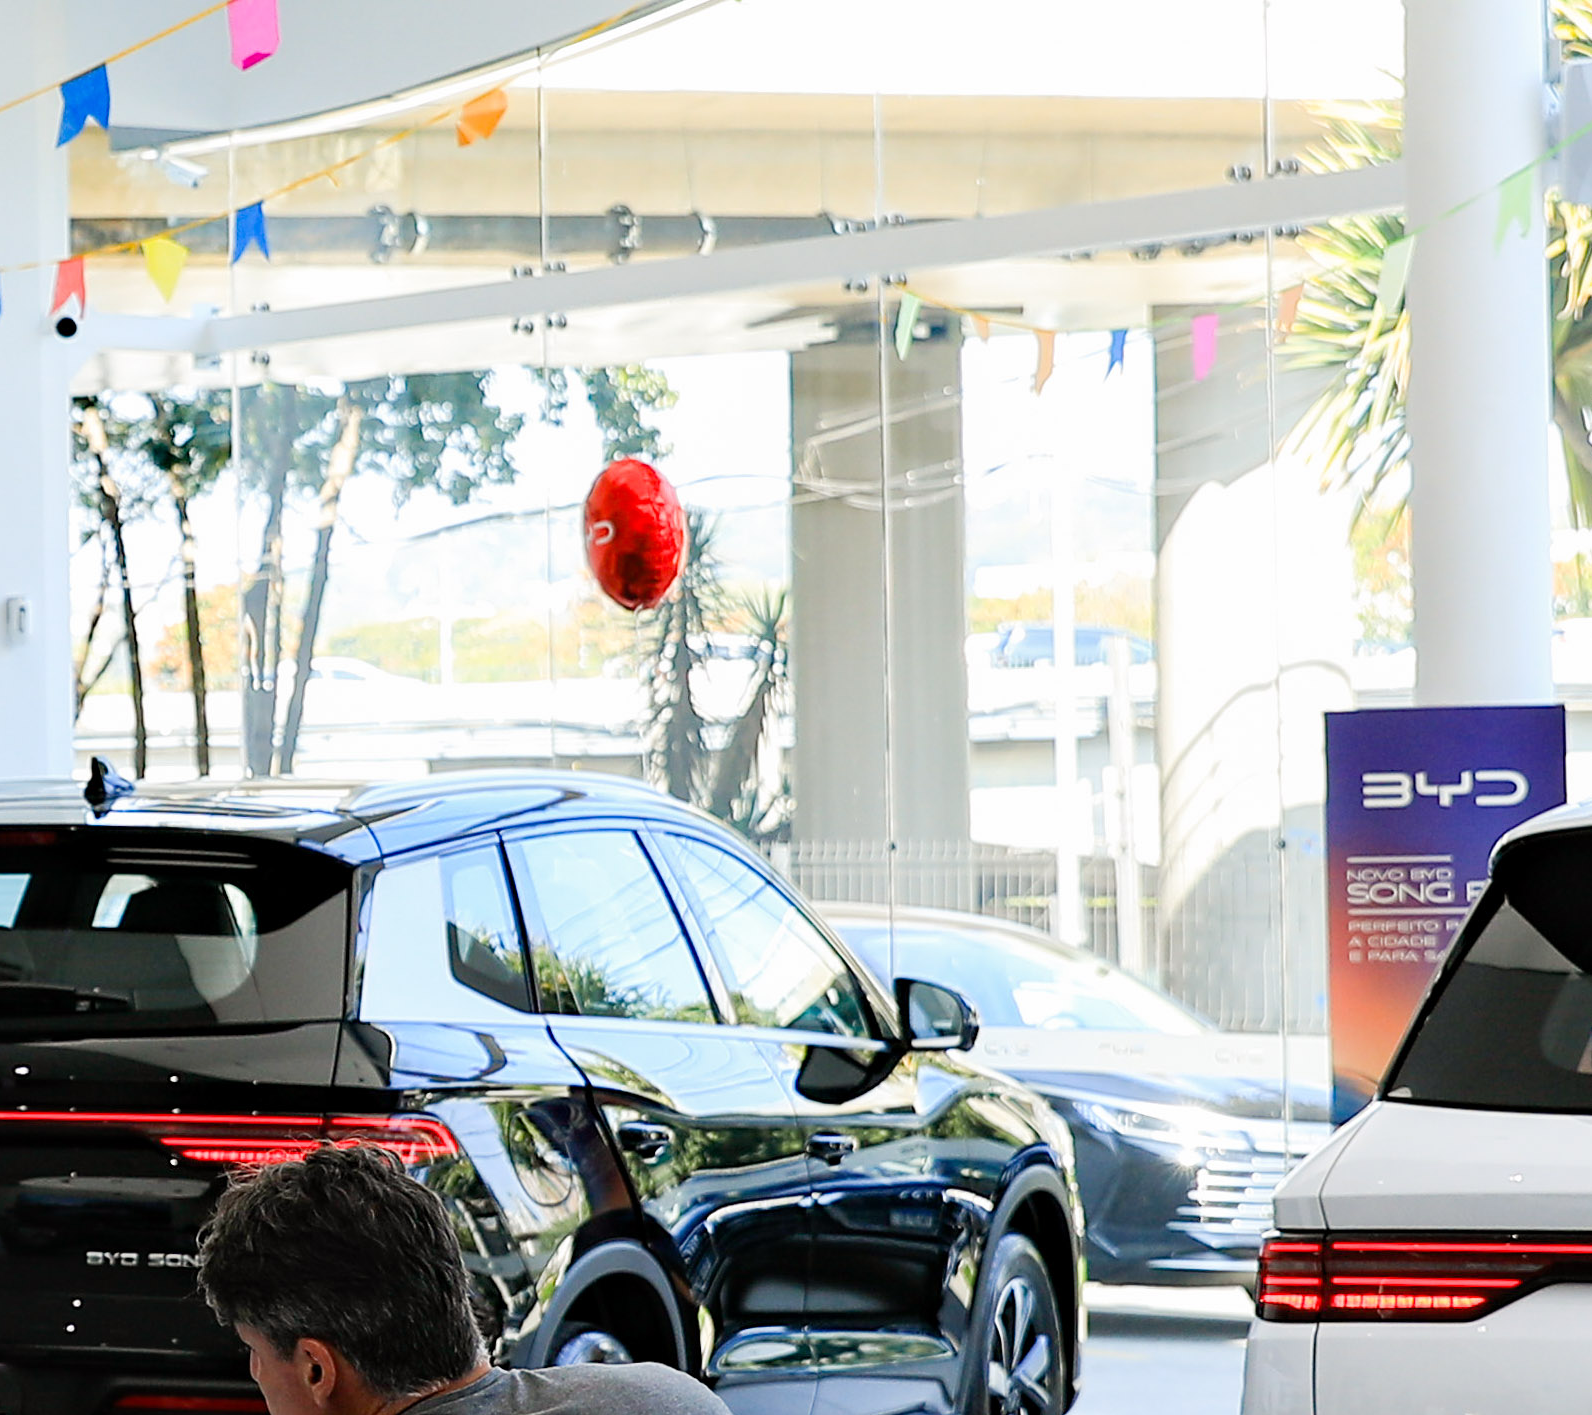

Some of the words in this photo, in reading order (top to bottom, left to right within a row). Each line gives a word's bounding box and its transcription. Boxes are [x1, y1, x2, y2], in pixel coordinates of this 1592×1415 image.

[1361, 770, 1531, 809] BYD
[1346, 868, 1404, 882] NOVO
[1410, 867, 1453, 881] BYD
[1346, 882, 1455, 905] SONG
[1348, 920, 1439, 933] PERFEITO
[1348, 936, 1362, 948] A
[1367, 935, 1437, 948] CIDADE
[1349, 950, 1362, 962] E
[1368, 949, 1419, 962] PARA
[86, 1251, 139, 1267] BYD
[147, 1252, 205, 1267] SON
